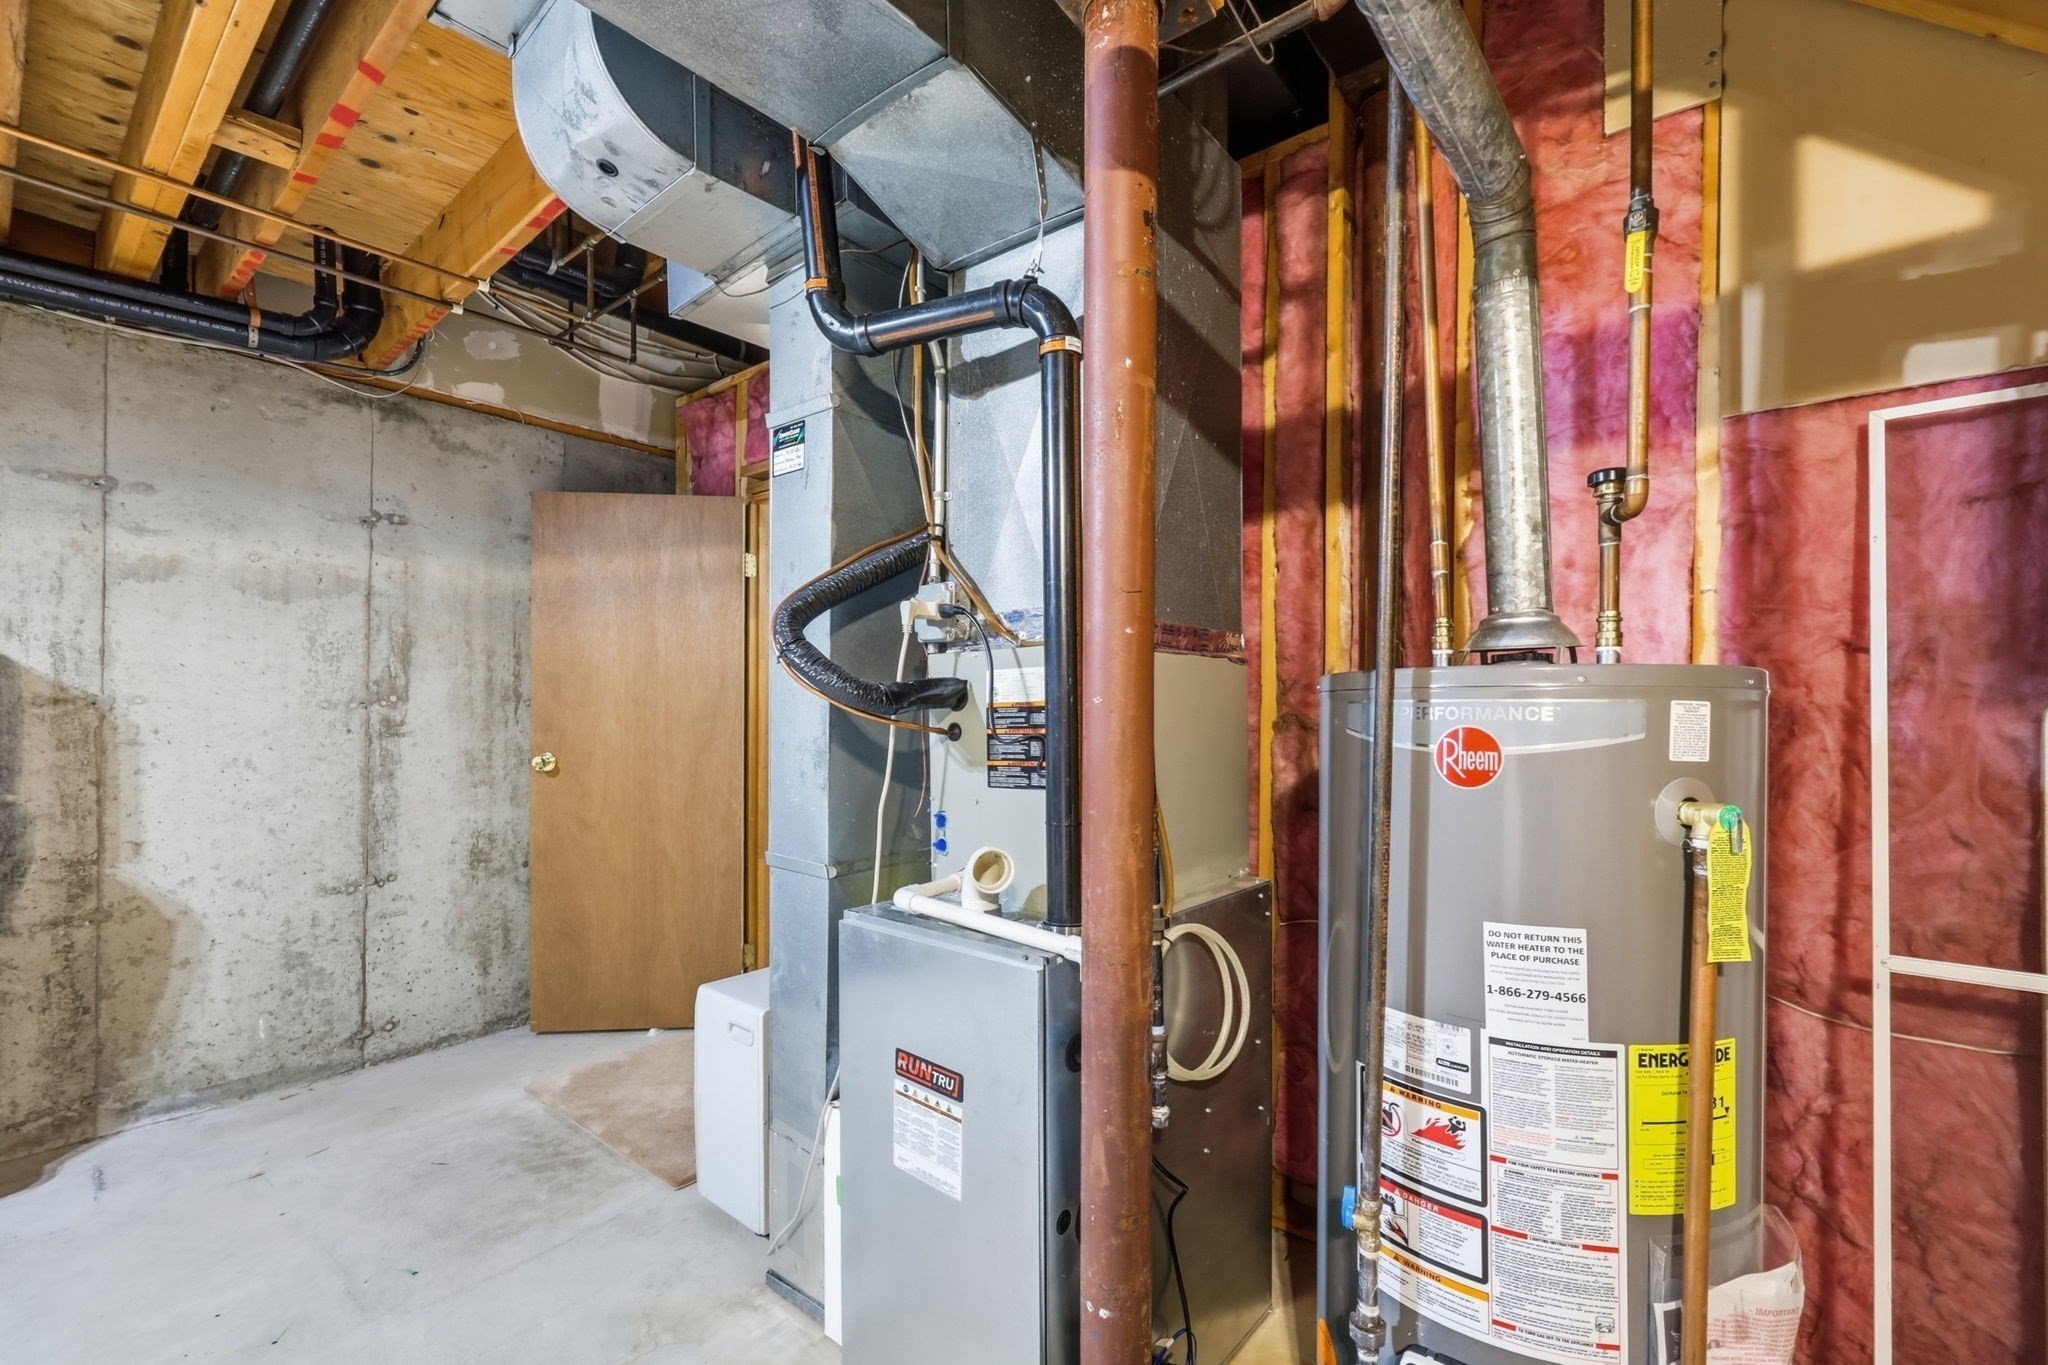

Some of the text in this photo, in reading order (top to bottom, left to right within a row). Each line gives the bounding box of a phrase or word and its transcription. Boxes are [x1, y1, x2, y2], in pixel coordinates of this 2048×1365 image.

[1401, 706, 1554, 721] PERFORMANCE
[1443, 728, 1498, 779] Rheem
[1488, 930, 1501, 938] DO
[1524, 933, 1560, 943] RETURN
[1562, 936, 1582, 944] THIS
[1486, 940, 1584, 955] WATER HEATER TO THE
[1490, 951, 1580, 966] PLACE OF PURCHASE
[1487, 984, 1586, 1004] 1-866-279-4566
[1505, 1041, 1540, 1050] INSTALLATION
[1552, 1047, 1580, 1055] OPERATION
[1508, 1050, 1537, 1059] AUTOMATIC
[1399, 1088, 1441, 1109] WARNING
[1402, 1193, 1439, 1213] DANGER
[1403, 1260, 1441, 1283] WARNING
[1755, 1307, 1800, 1317] IMPORTANT
